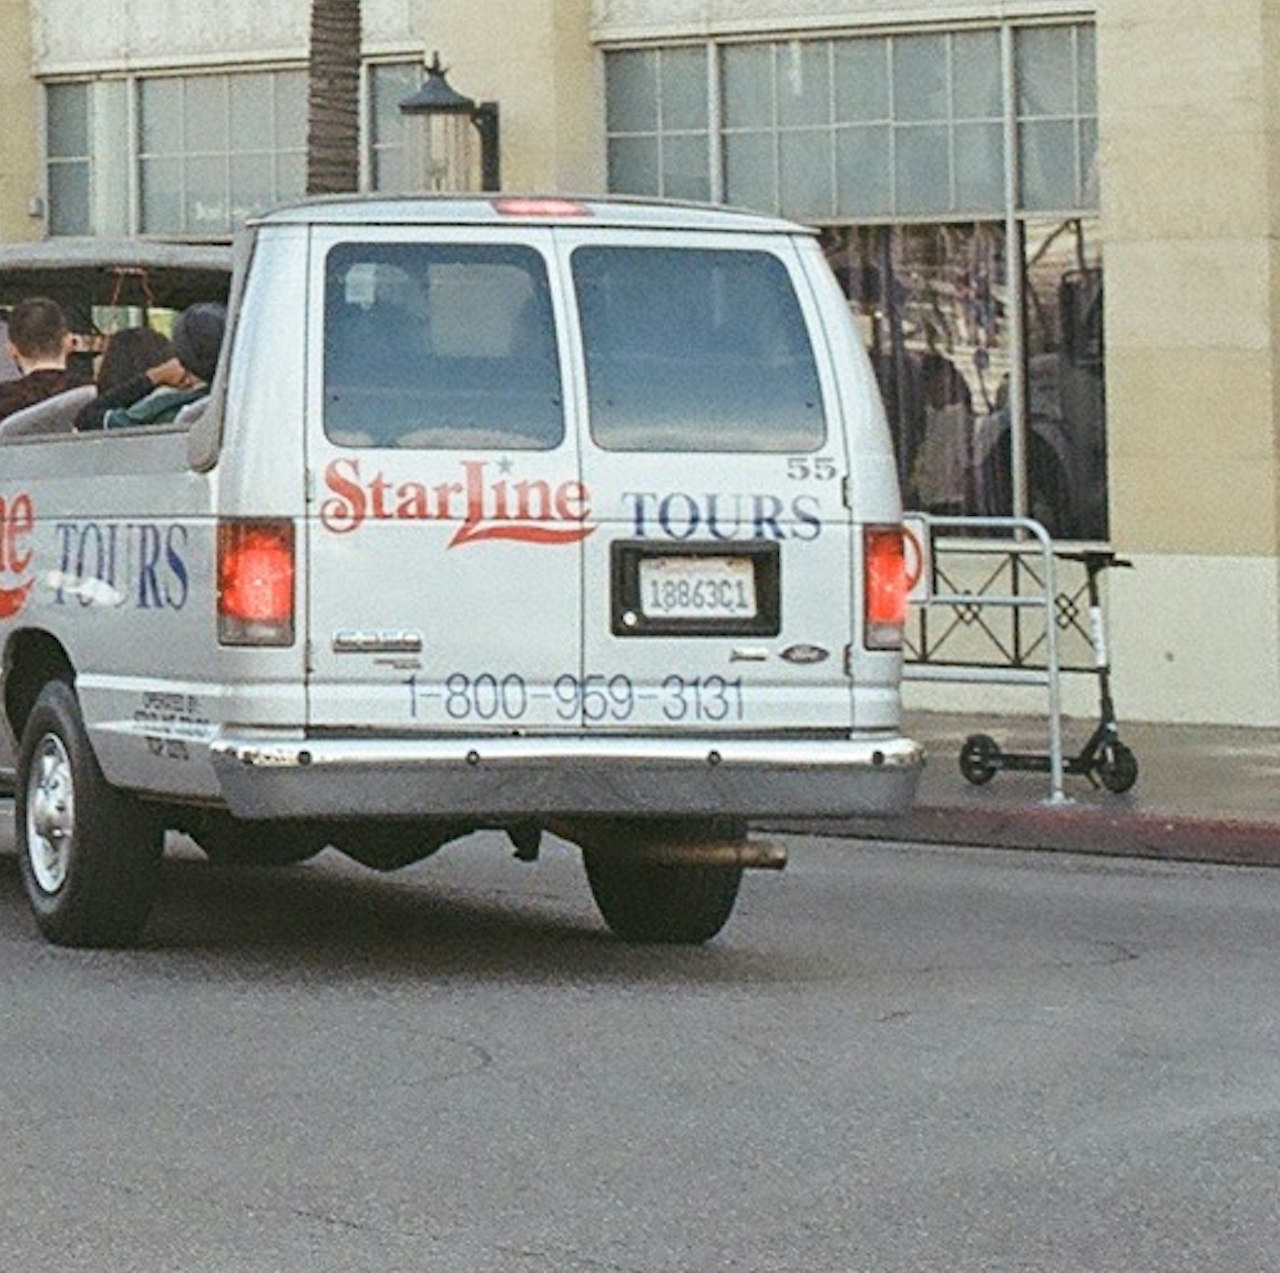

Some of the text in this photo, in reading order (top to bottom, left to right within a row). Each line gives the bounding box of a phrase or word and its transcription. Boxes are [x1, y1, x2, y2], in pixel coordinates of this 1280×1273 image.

[786, 456, 838, 482] 55
[622, 493, 822, 542] TOURS
[56, 522, 188, 610] TOURS
